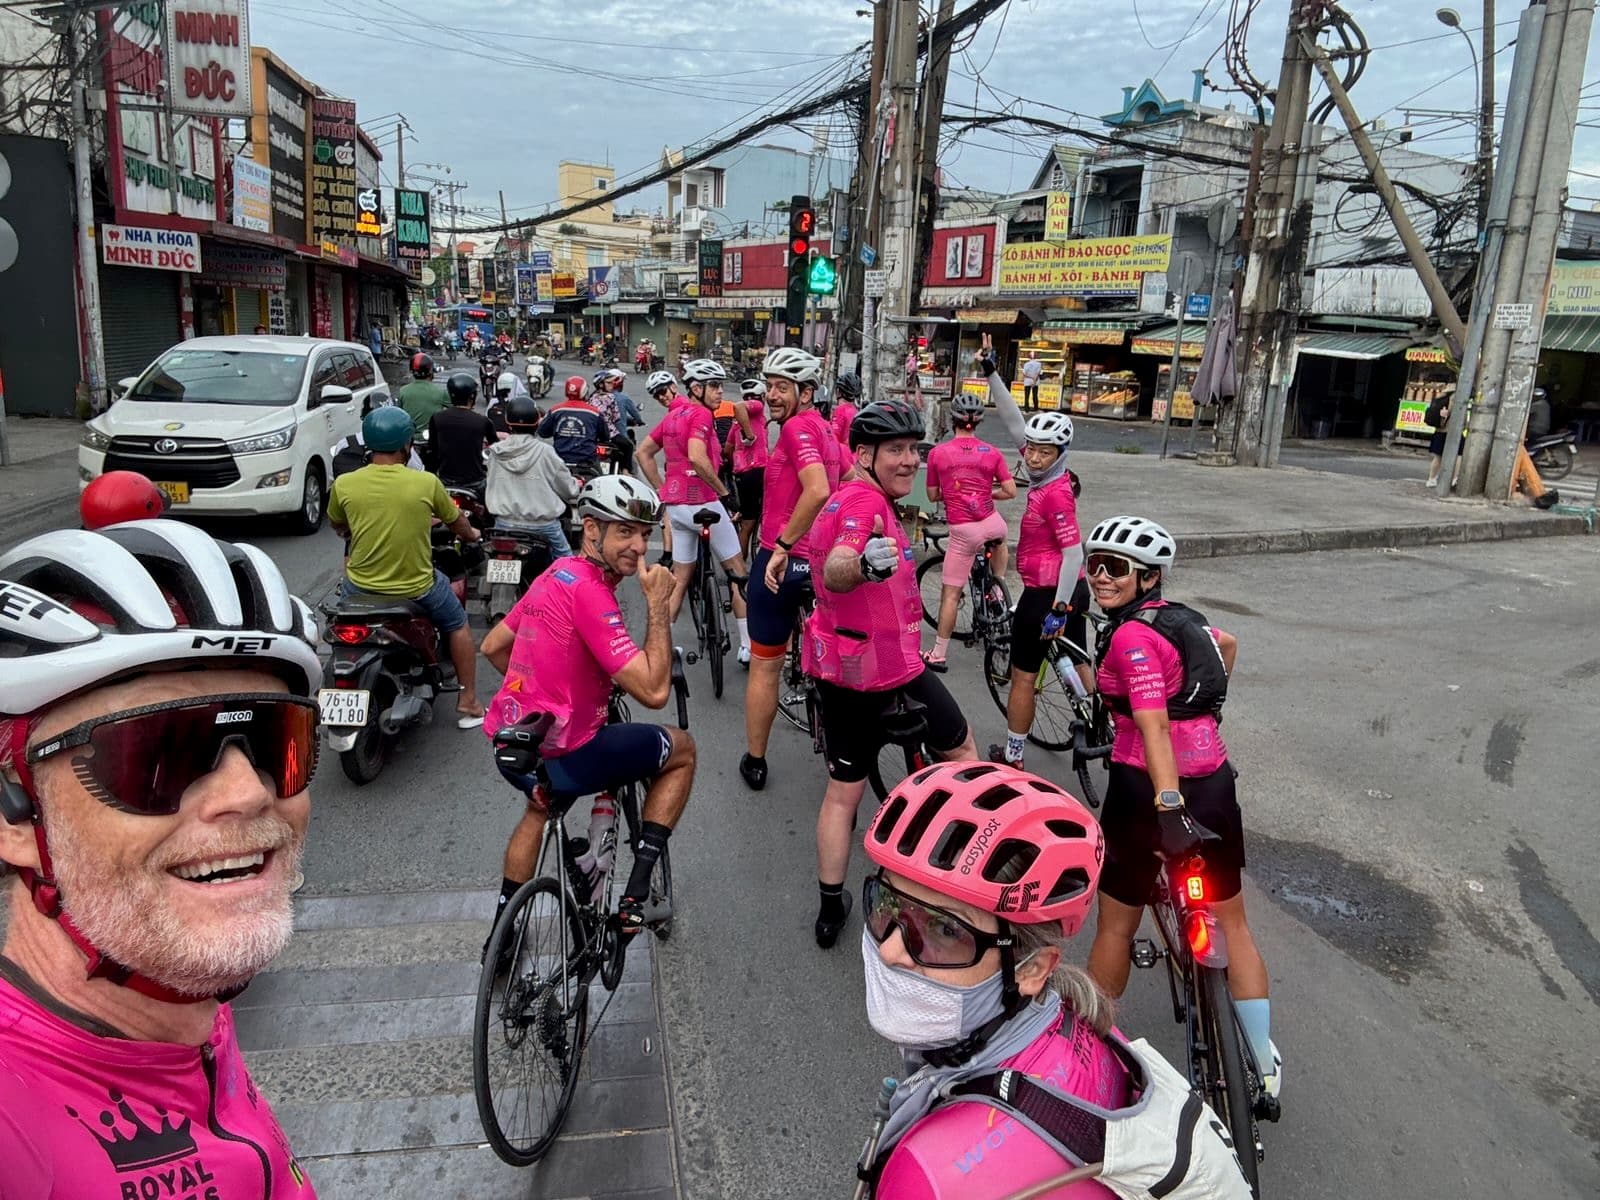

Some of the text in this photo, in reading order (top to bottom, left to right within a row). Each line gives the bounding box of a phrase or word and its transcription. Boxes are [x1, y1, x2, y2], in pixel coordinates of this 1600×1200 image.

[175, 11, 239, 47] MINH
[185, 60, 235, 102] ĐỨC
[400, 192, 424, 216] NHA
[398, 219, 429, 244] KHOA
[801, 213, 811, 232] 2
[125, 229, 193, 247] NHA KHOA
[105, 245, 153, 265] MINH
[158, 247, 195, 269] ĐỨC
[1021, 246, 1050, 260] BÁNH
[1069, 242, 1092, 258] BẢO
[1096, 244, 1131, 258] NGỌC
[1005, 271, 1035, 283] BÁNH
[1061, 269, 1082, 282] XÔI
[1092, 268, 1129, 281] BÁNH
[0, 582, 70, 621] ET
[191, 636, 278, 655] MET
[326, 692, 359, 706] 76-G1
[1142, 690, 1161, 699] 2025
[320, 708, 364, 724] 441.80
[960, 818, 1002, 876] easypost
[120, 1160, 214, 1200] ROYAL
